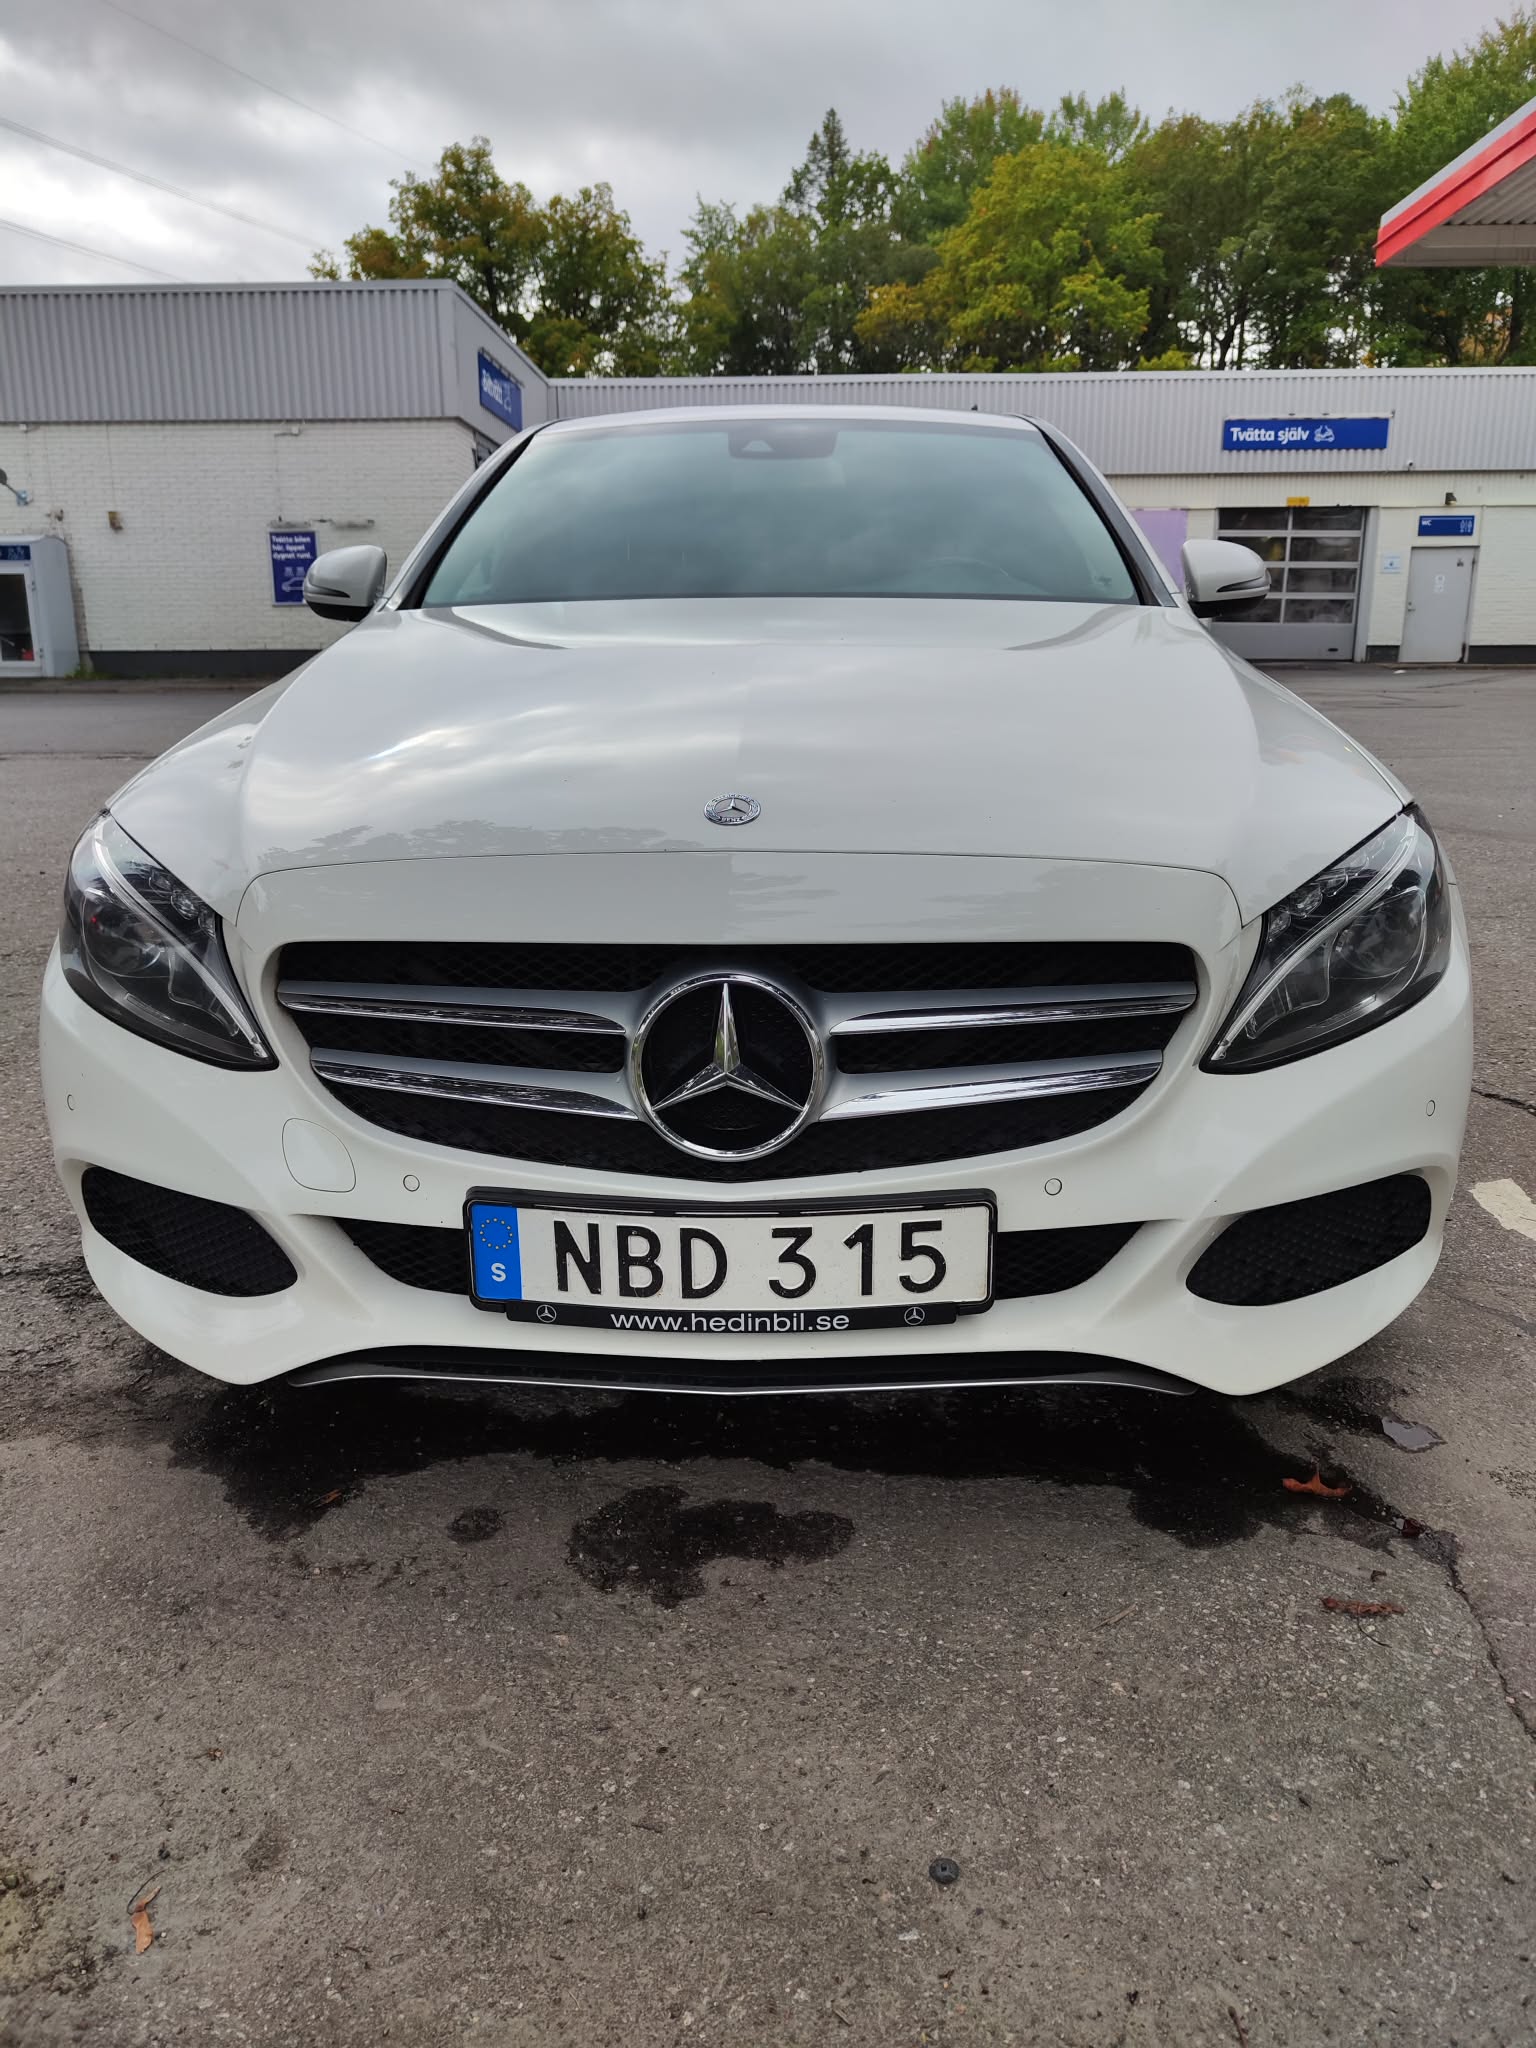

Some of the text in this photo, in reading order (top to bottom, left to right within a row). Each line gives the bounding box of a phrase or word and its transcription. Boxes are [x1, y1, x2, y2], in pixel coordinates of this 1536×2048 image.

[1230, 427, 1309, 444] Tvätta själv
[553, 1219, 947, 1300] NBD 315
[490, 1262, 507, 1282] S
[610, 1313, 850, 1332] www.hedinbil.se
